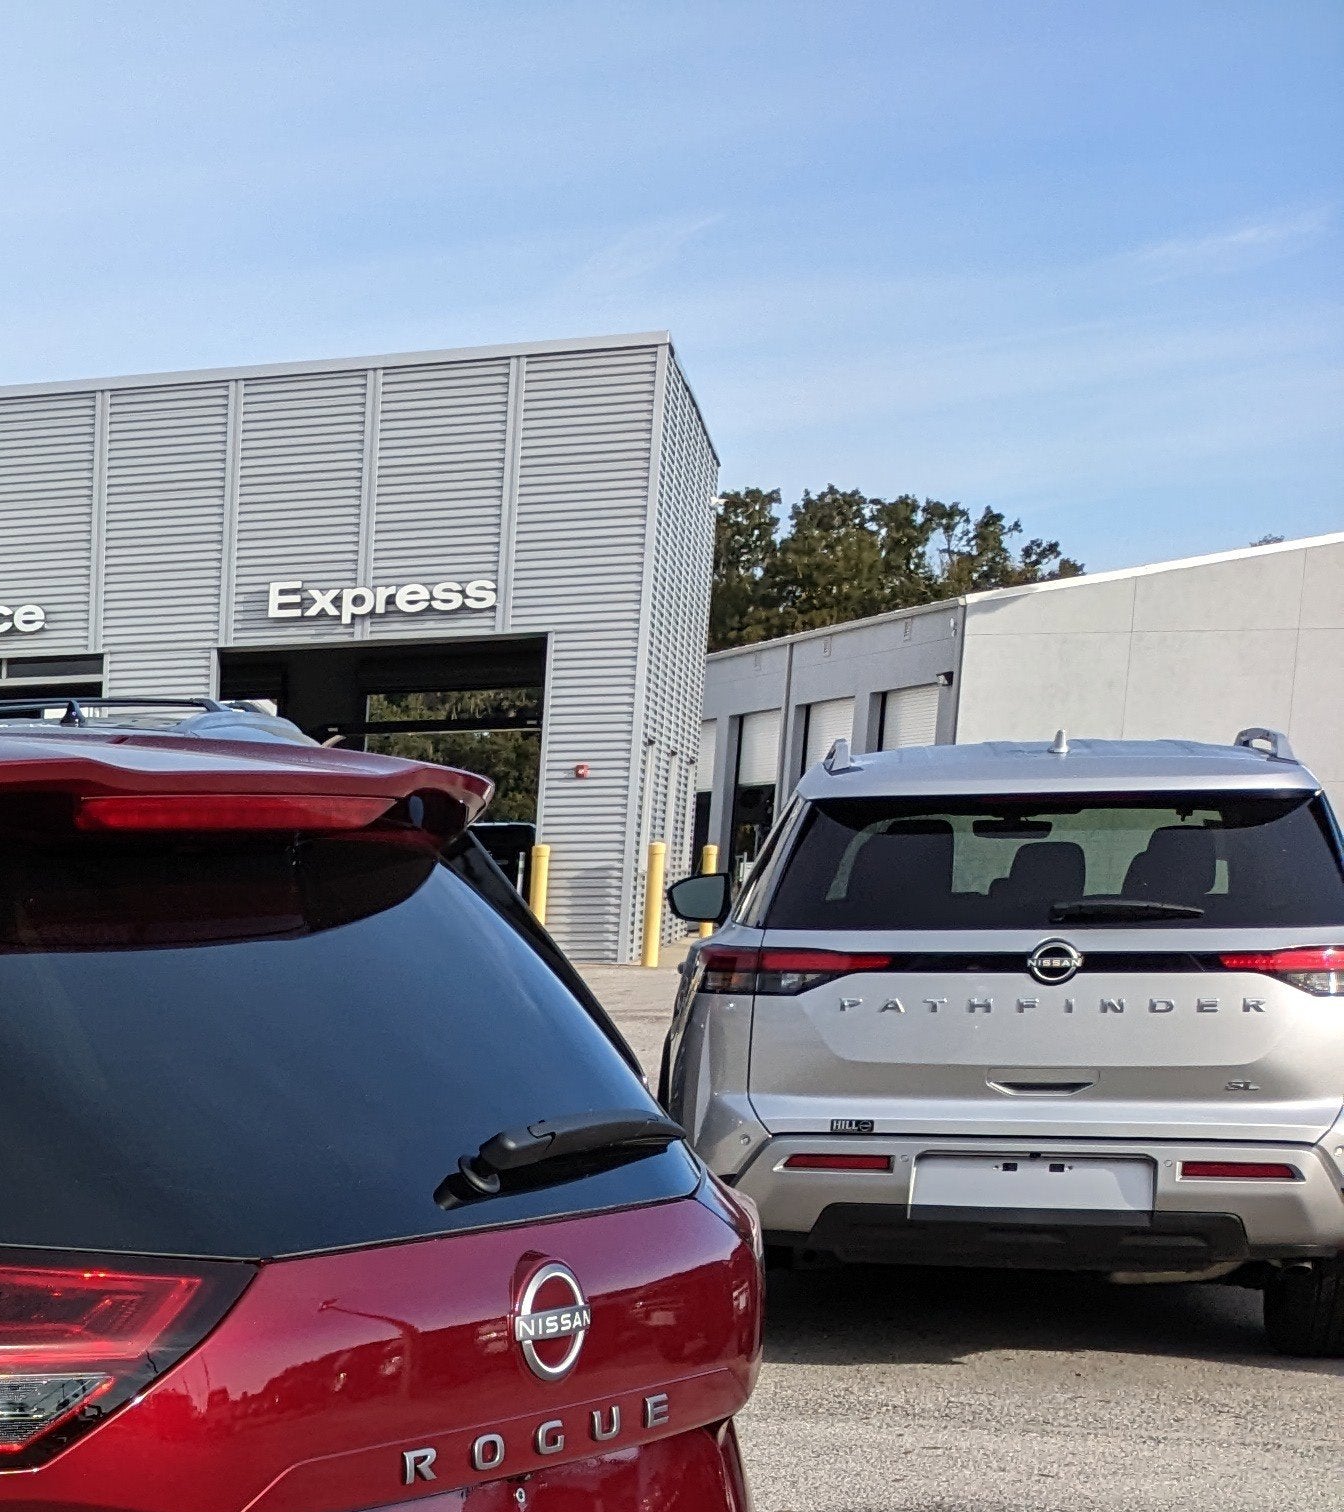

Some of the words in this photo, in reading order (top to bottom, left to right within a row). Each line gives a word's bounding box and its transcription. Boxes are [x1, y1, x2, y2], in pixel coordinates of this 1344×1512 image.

[267, 579, 497, 625] Express
[1026, 957, 1083, 968] NISSAN
[839, 996, 1269, 1015] PATHFINDER
[832, 1120, 859, 1131] HILL
[519, 1308, 591, 1338] NISSAN
[402, 1393, 670, 1486] ROGUE
